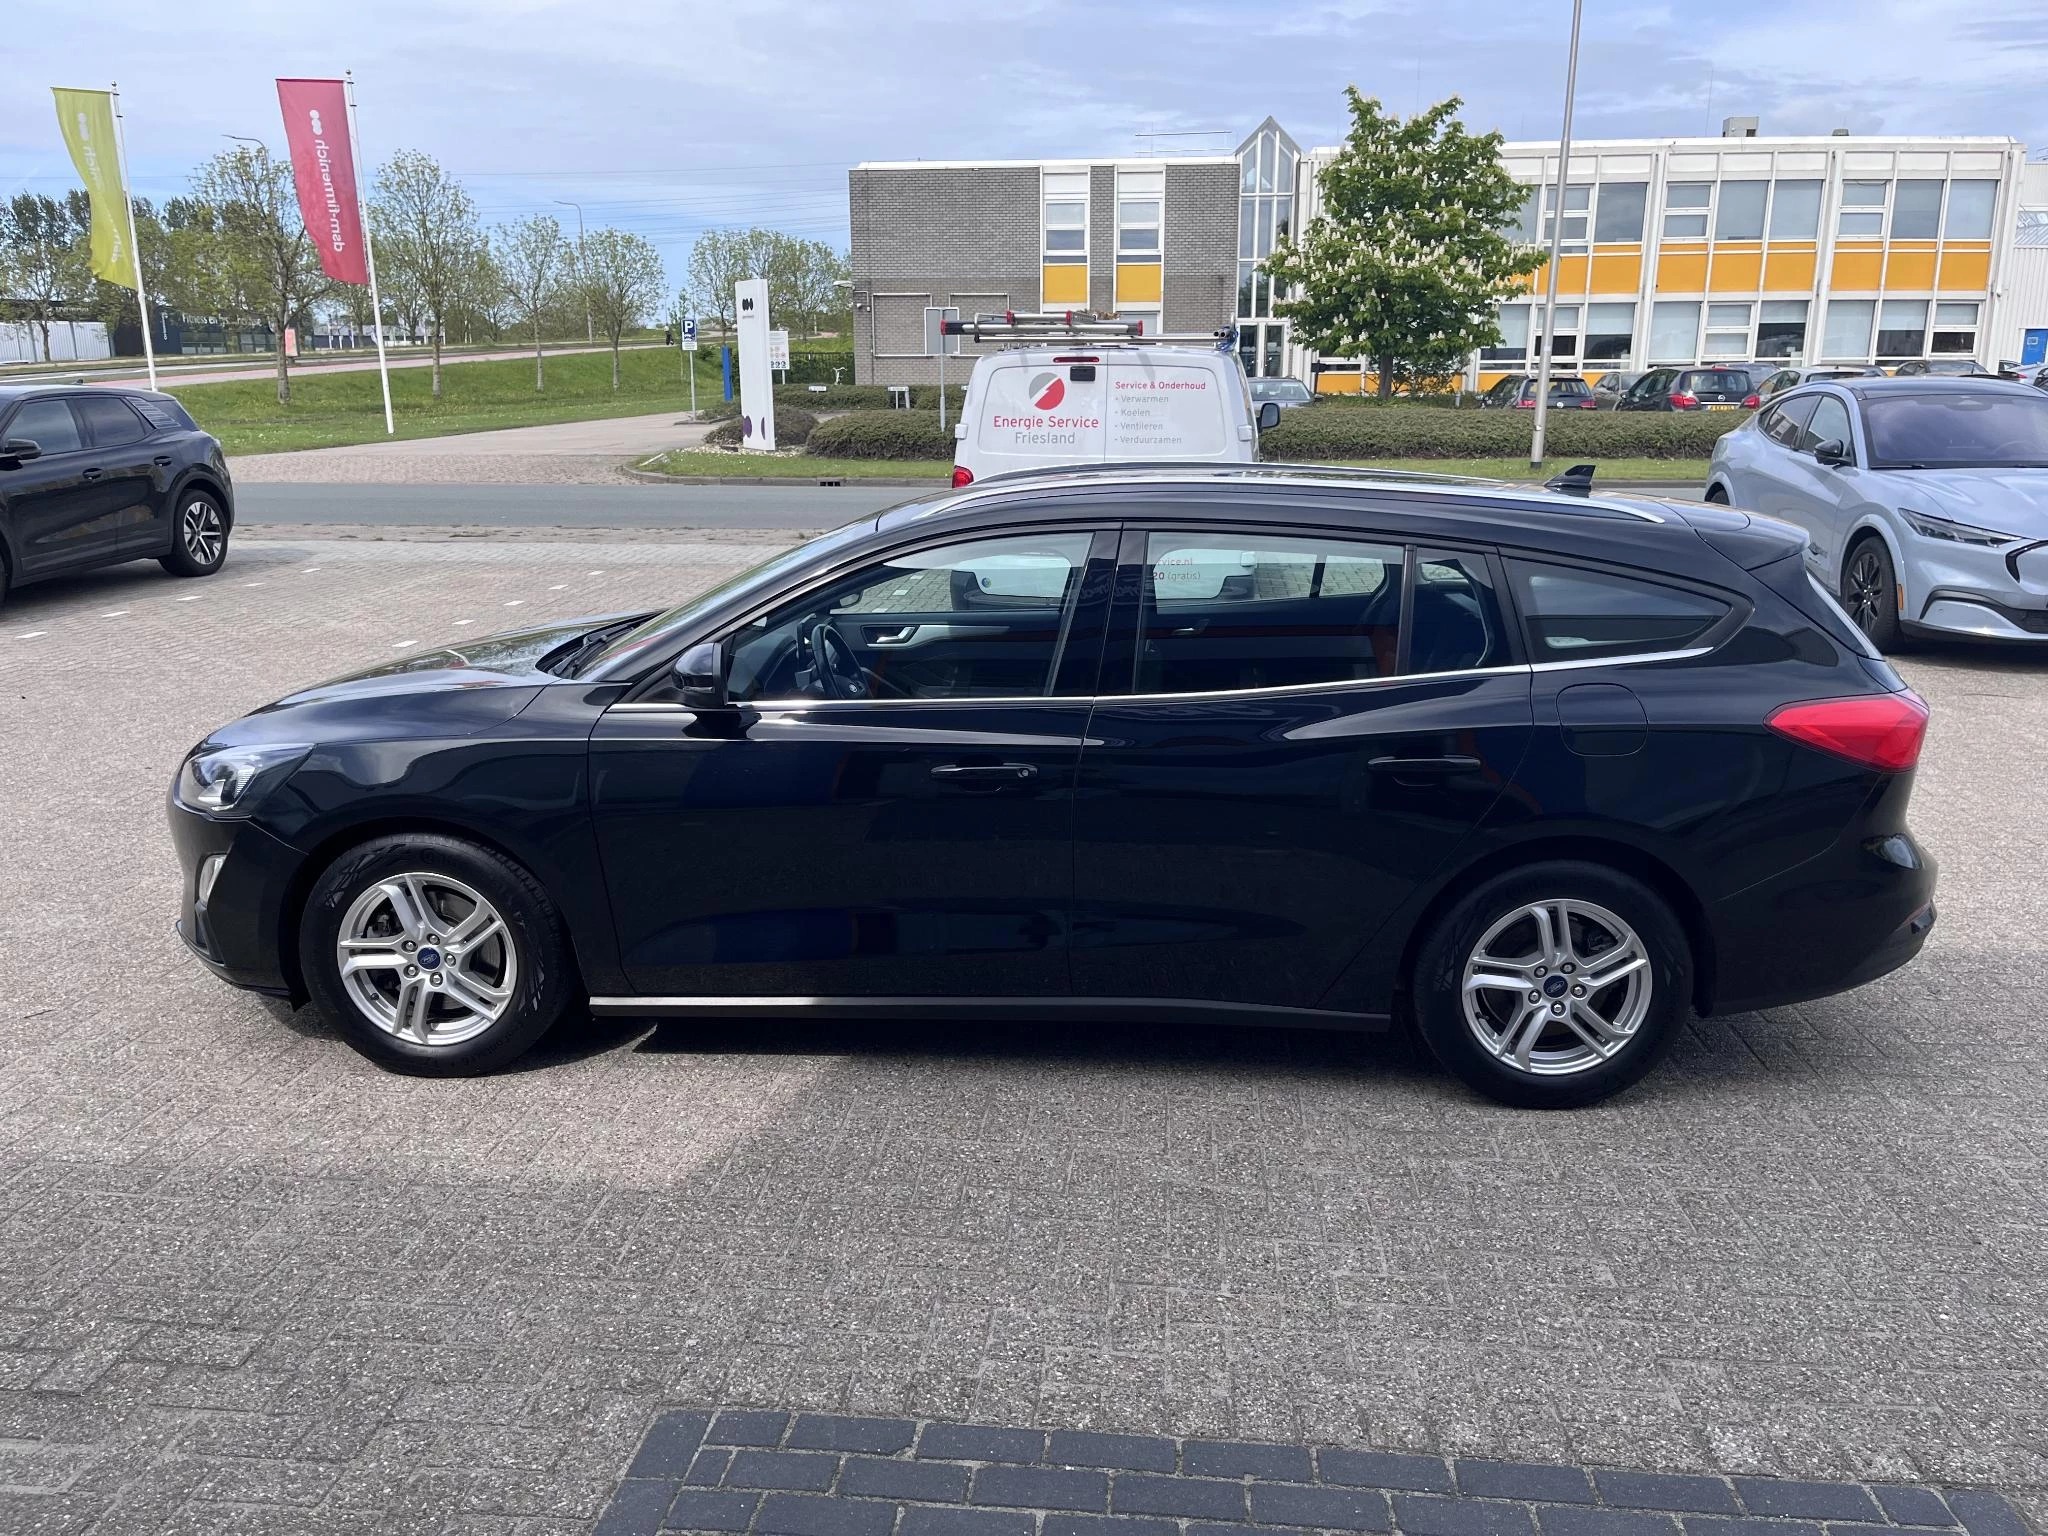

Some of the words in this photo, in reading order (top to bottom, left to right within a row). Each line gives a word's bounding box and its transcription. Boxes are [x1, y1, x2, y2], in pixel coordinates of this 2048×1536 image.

[684, 320, 694, 332] P
[1115, 381, 1147, 390] Service
[1149, 381, 1156, 390] &
[1159, 381, 1206, 390] Onderhoud
[1121, 395, 1169, 403] Verwarmen
[1121, 408, 1151, 417] Koelen
[993, 415, 1044, 430] Energie
[1048, 415, 1099, 428] Service
[1120, 422, 1163, 431] Ventileren
[1015, 432, 1076, 444] Friesland
[1120, 436, 1182, 444] Verduurzamen
[1168, 571, 1201, 581] (gratis)
